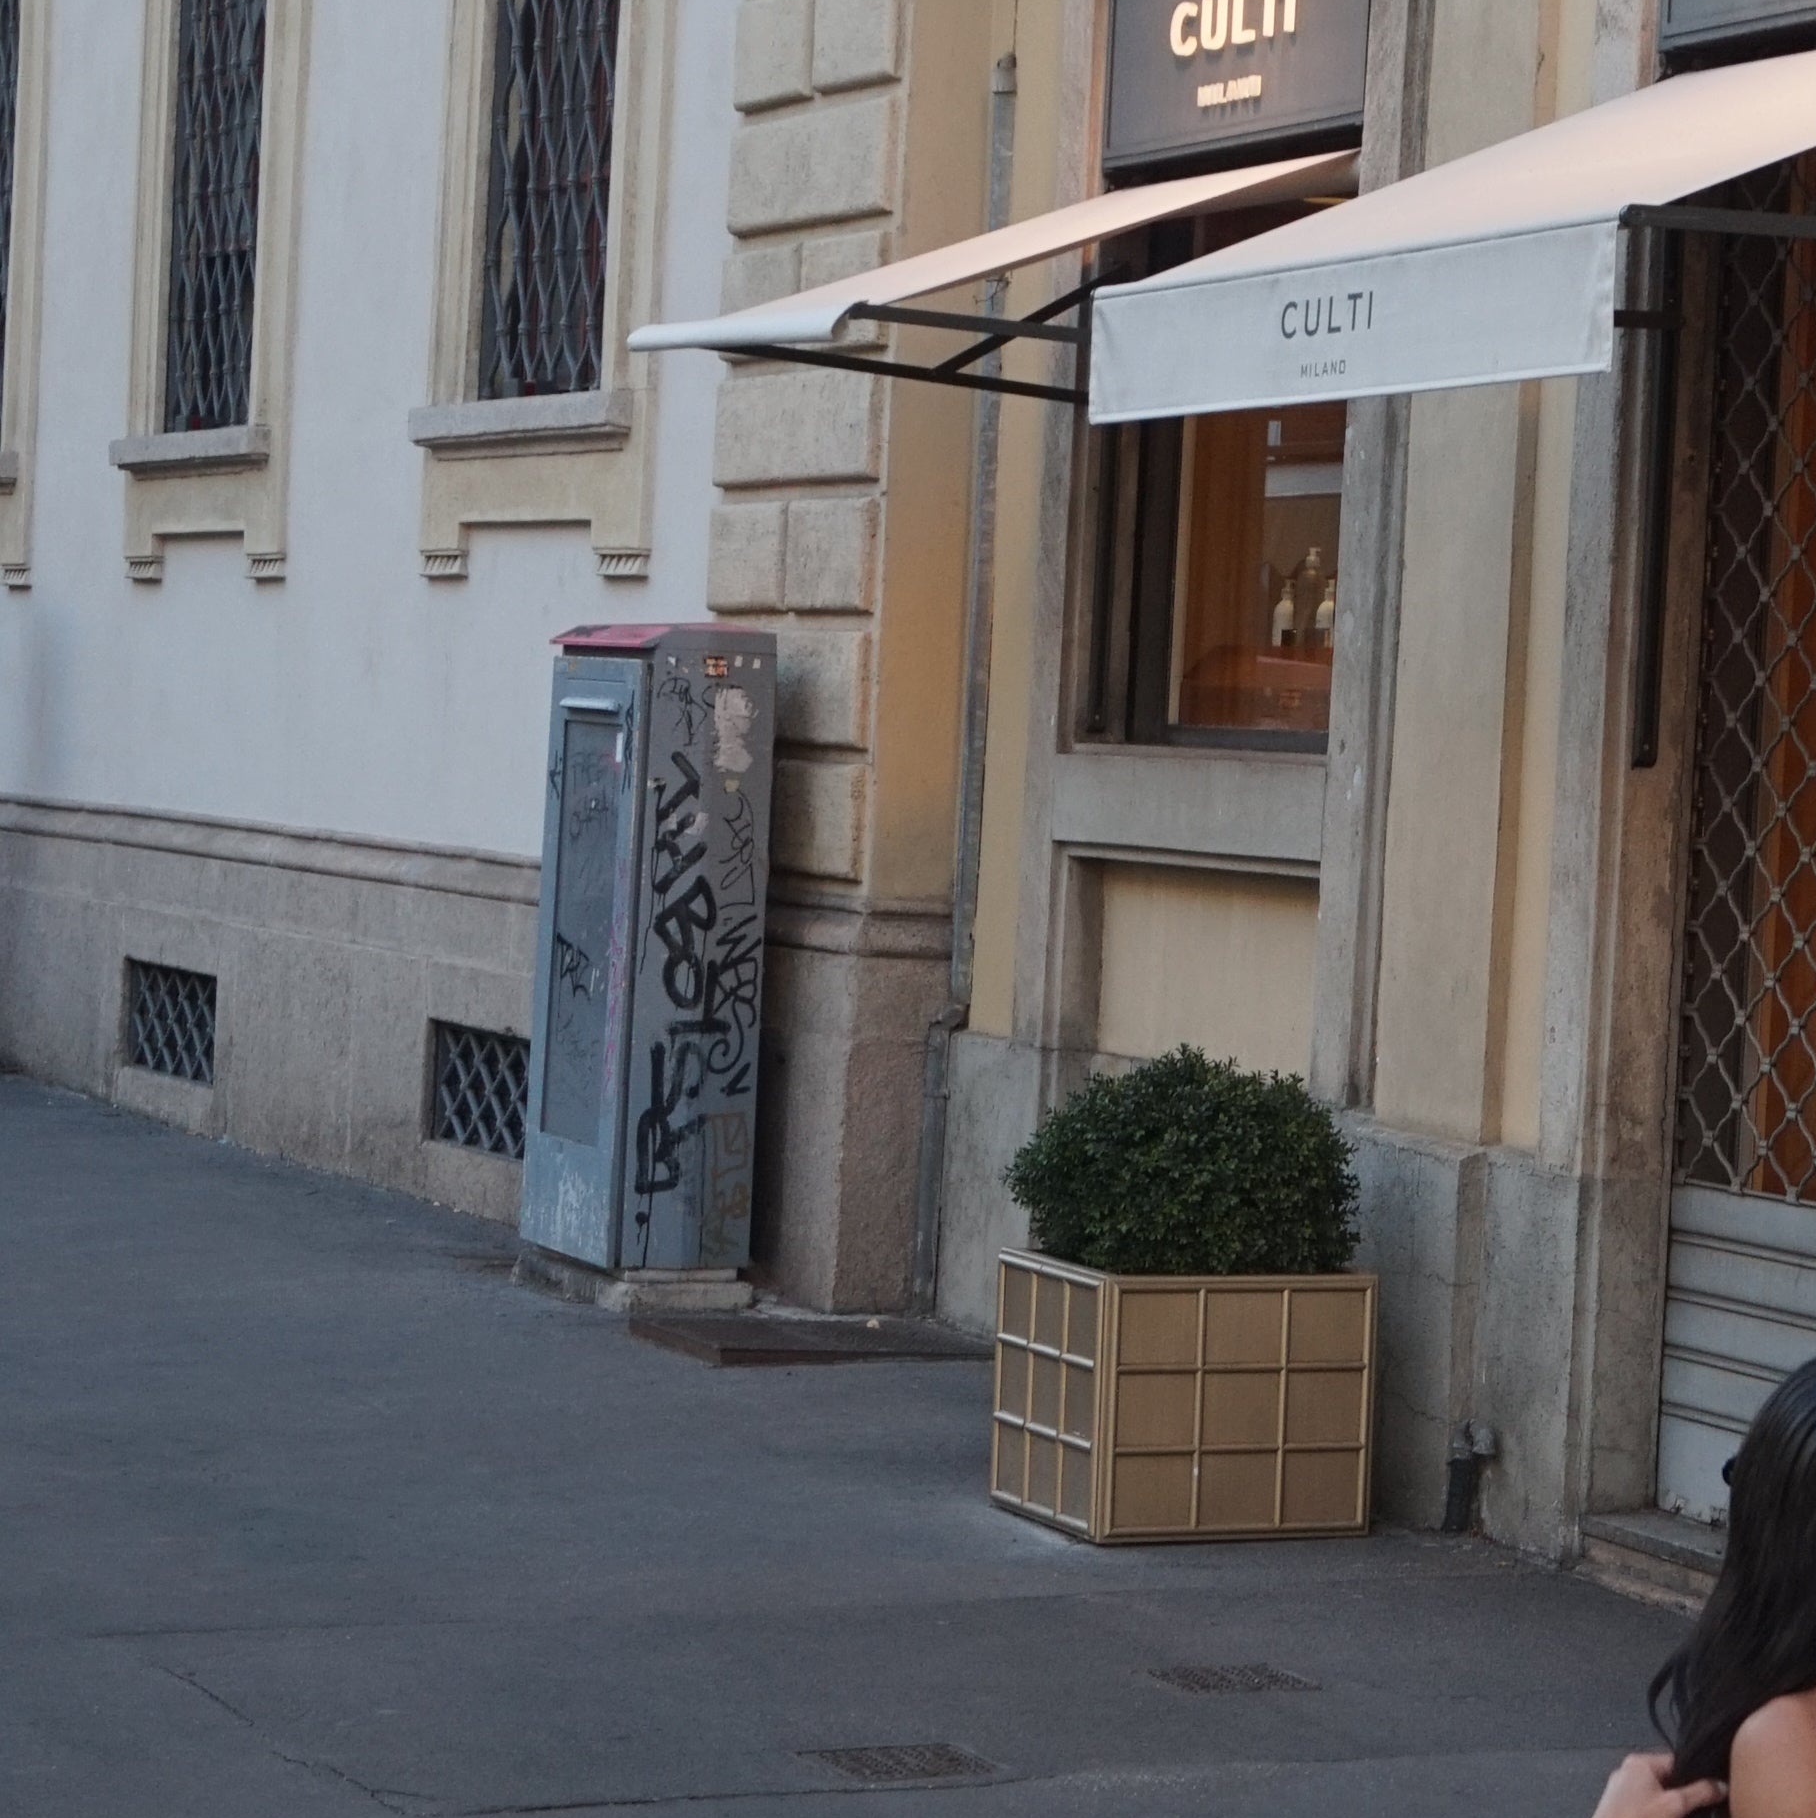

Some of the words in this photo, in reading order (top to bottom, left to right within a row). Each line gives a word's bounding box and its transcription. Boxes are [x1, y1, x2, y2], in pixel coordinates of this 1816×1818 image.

[1197, 75, 1263, 108] MILANO
[1281, 290, 1374, 340] CULTI
[1300, 359, 1347, 379] MILANO
